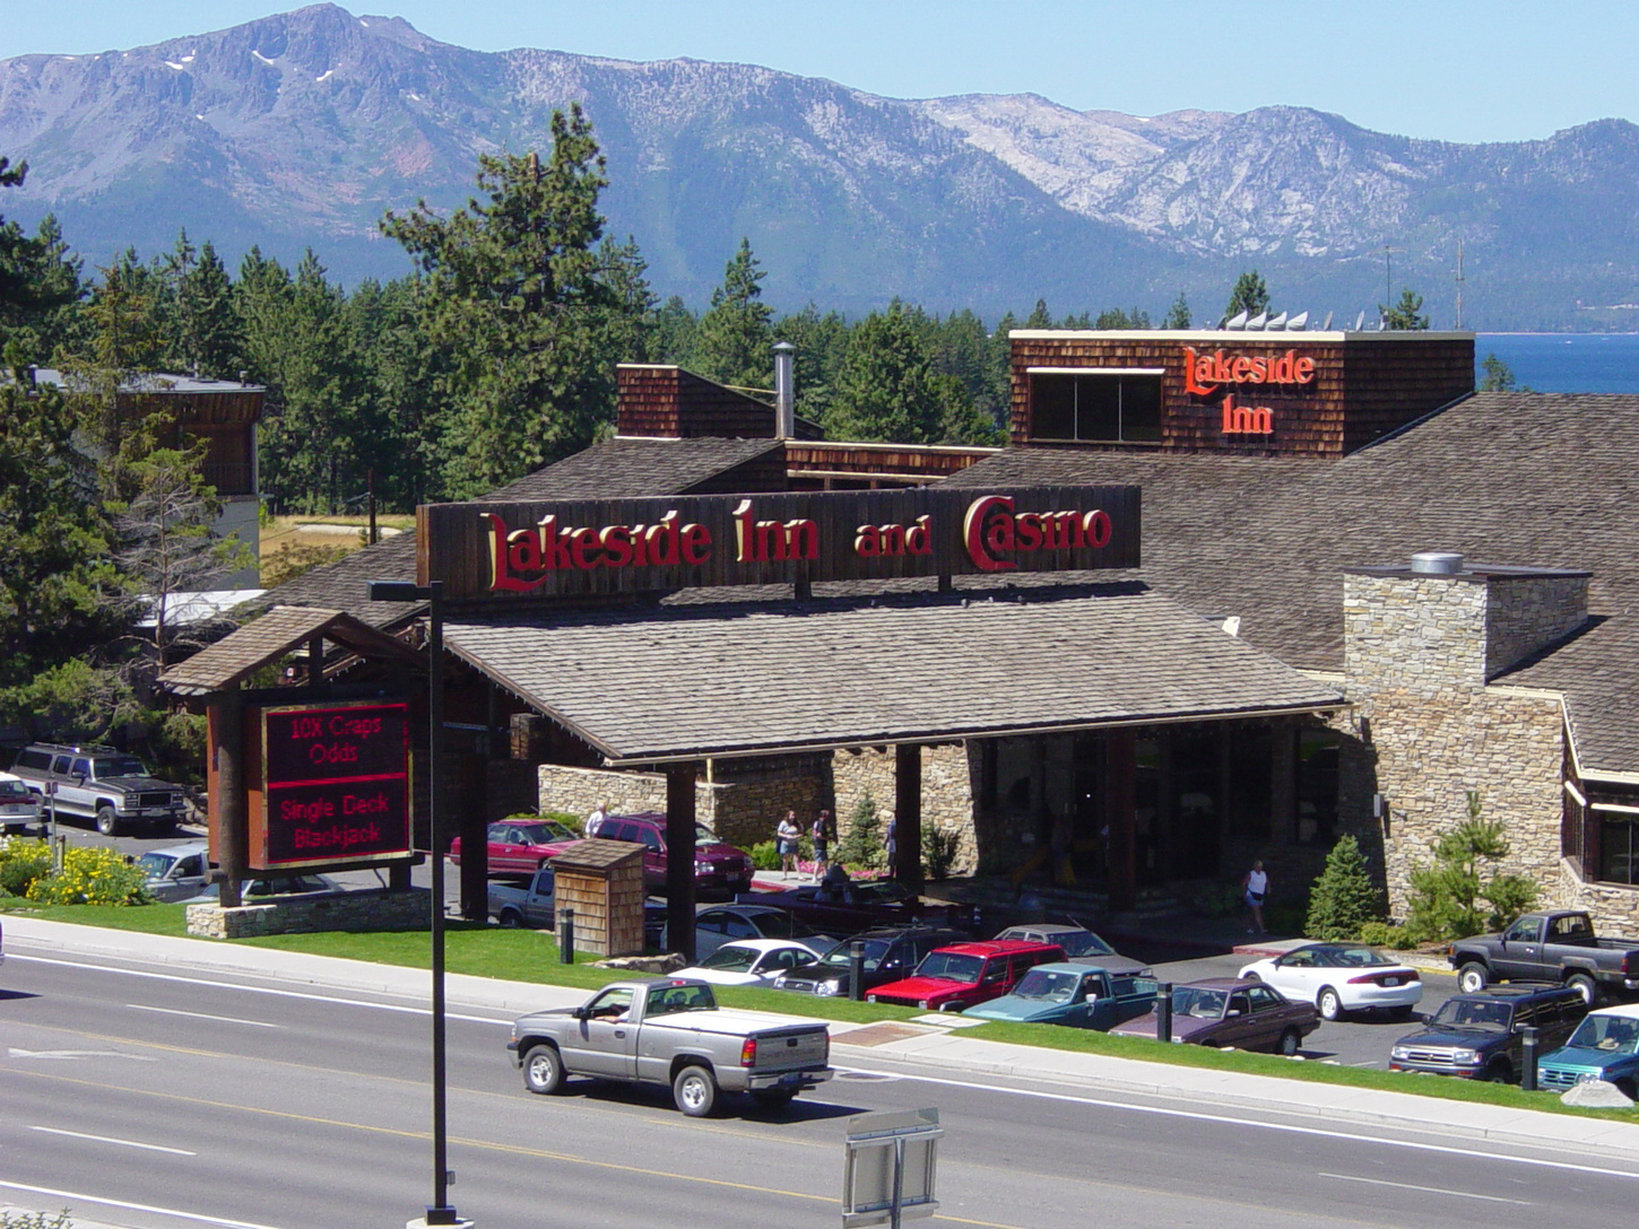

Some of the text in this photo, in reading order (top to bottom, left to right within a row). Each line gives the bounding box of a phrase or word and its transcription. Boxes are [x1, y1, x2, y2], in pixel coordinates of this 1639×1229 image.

[1182, 346, 1315, 395] Lakeside
[1222, 393, 1274, 433] Inn
[480, 495, 1112, 592] Lakeside Inn and Casino
[291, 715, 383, 739] 10X Craps
[309, 742, 359, 764] Odds
[280, 792, 389, 823] Single Deck
[294, 822, 381, 849] Blackjack
